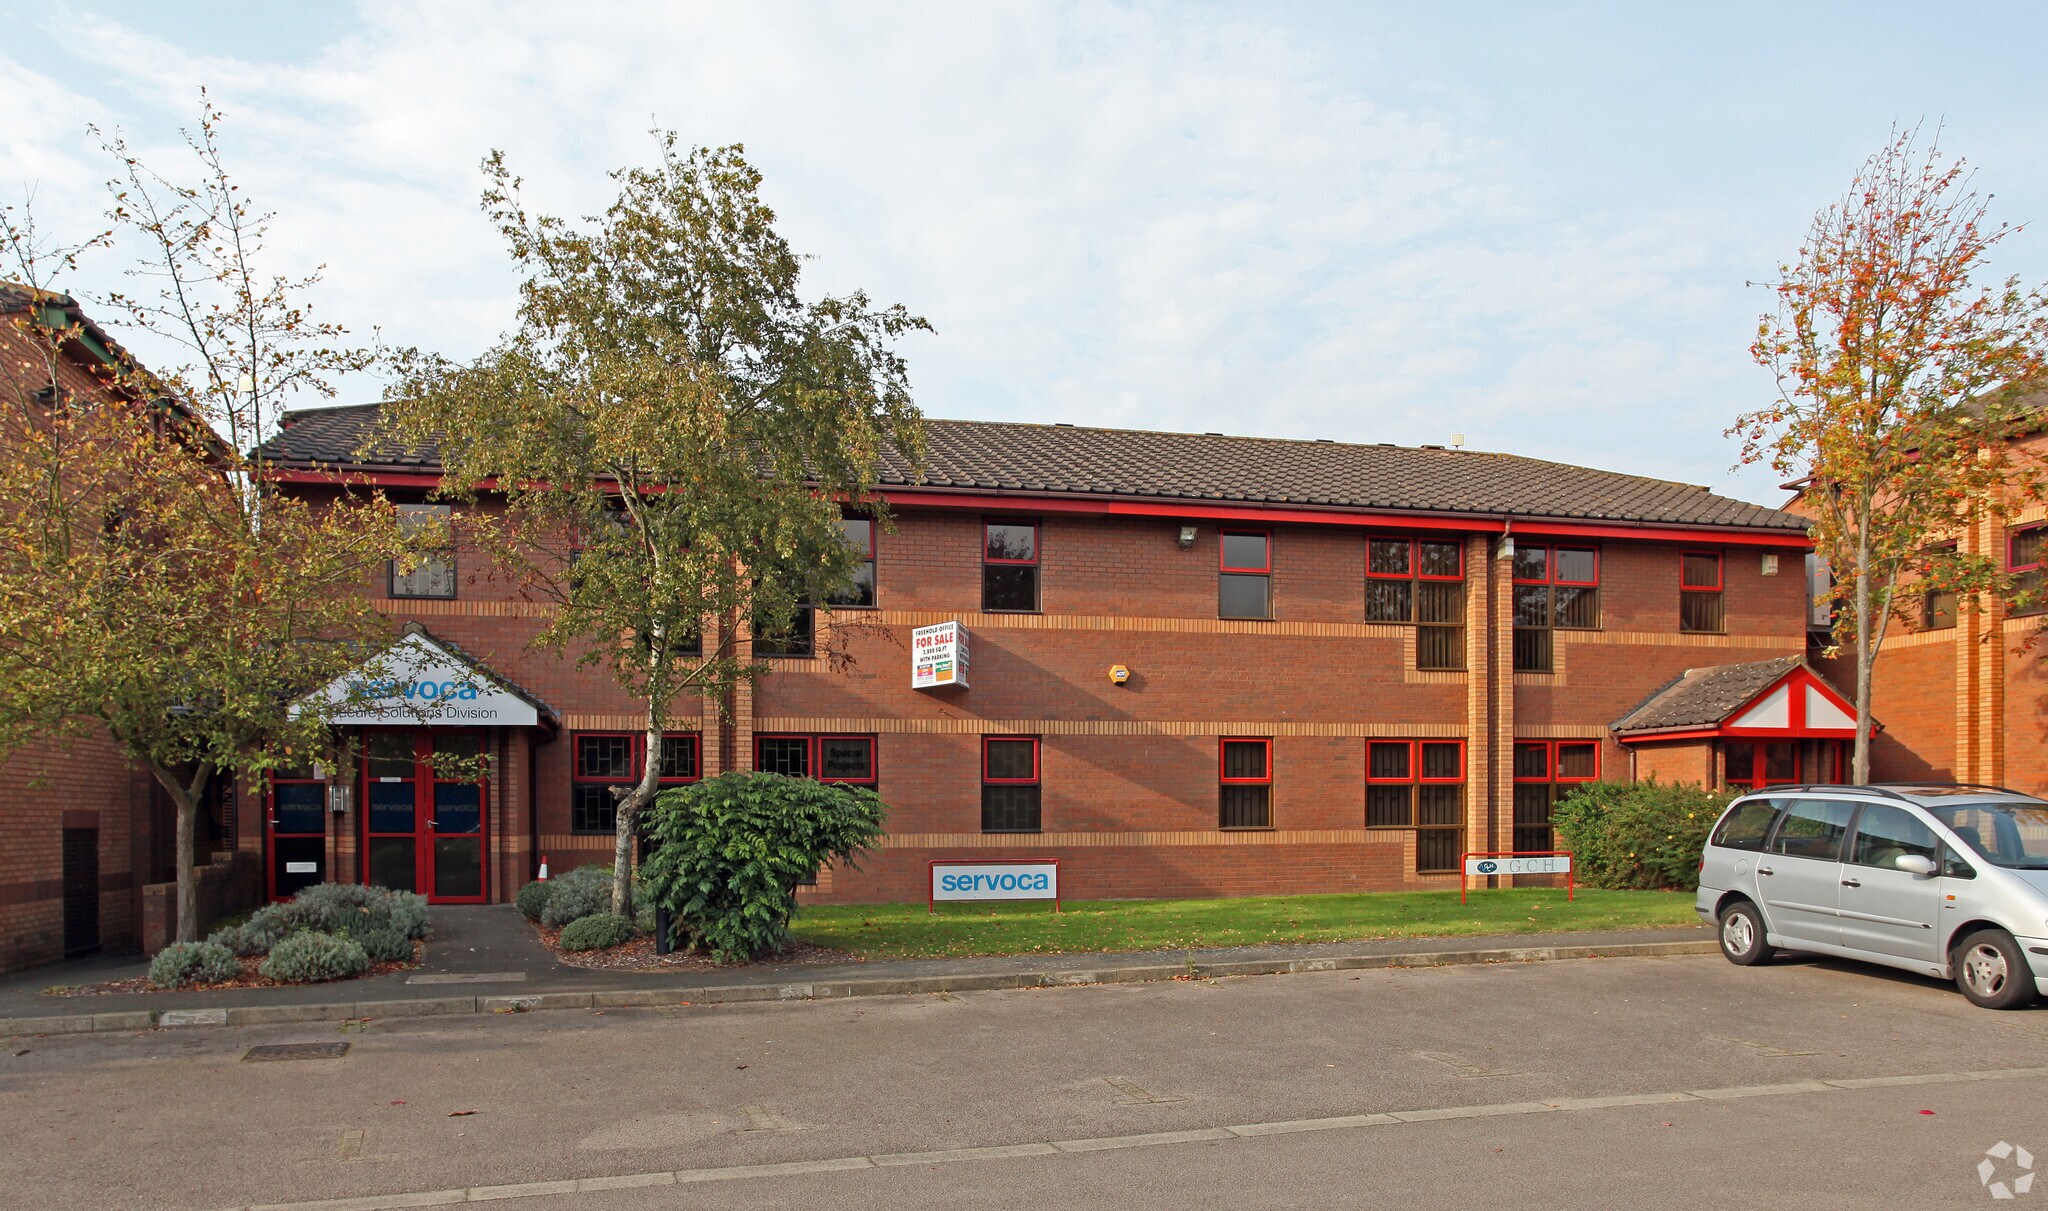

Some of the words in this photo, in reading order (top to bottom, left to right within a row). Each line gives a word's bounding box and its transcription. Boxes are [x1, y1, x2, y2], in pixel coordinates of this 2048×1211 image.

[915, 627, 938, 637] FREEHOLD
[939, 624, 954, 632] OFFICE
[916, 636, 932, 648] FOR
[935, 632, 954, 645] SALE
[932, 653, 950, 661] PARKING
[447, 707, 498, 719] Division
[830, 748, 863, 758] Special
[828, 760, 865, 771] Projects
[372, 803, 413, 812] servoca
[437, 803, 478, 812] servoca
[941, 873, 1049, 891] servoca
